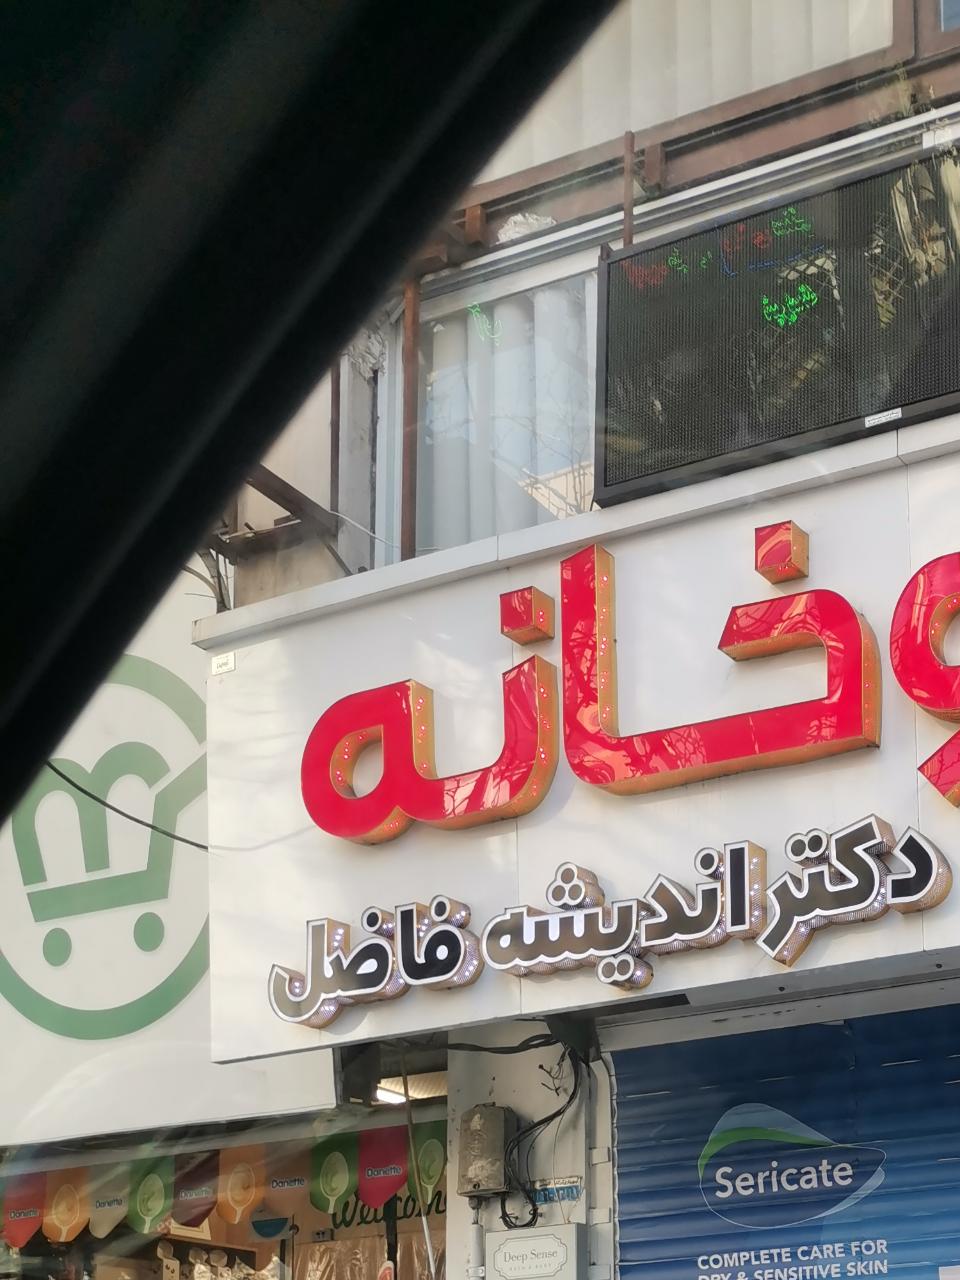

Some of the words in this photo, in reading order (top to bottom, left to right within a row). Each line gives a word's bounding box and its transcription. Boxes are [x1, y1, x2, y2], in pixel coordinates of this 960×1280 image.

[756, 814, 952, 967] دکتر
[480, 839, 767, 989] اندیشه
[267, 894, 484, 1028] فاضل
[271, 1176, 305, 1190] Danette
[366, 1165, 402, 1178] Danette
[714, 1159, 853, 1199] Sericate
[503, 1251, 528, 1264] Deep
[530, 1248, 558, 1260] Sense
[697, 1247, 792, 1270] COMPLETE
[796, 1243, 846, 1261] CARE
[851, 1239, 888, 1256] FOR
[846, 1259, 888, 1276] SKIN
